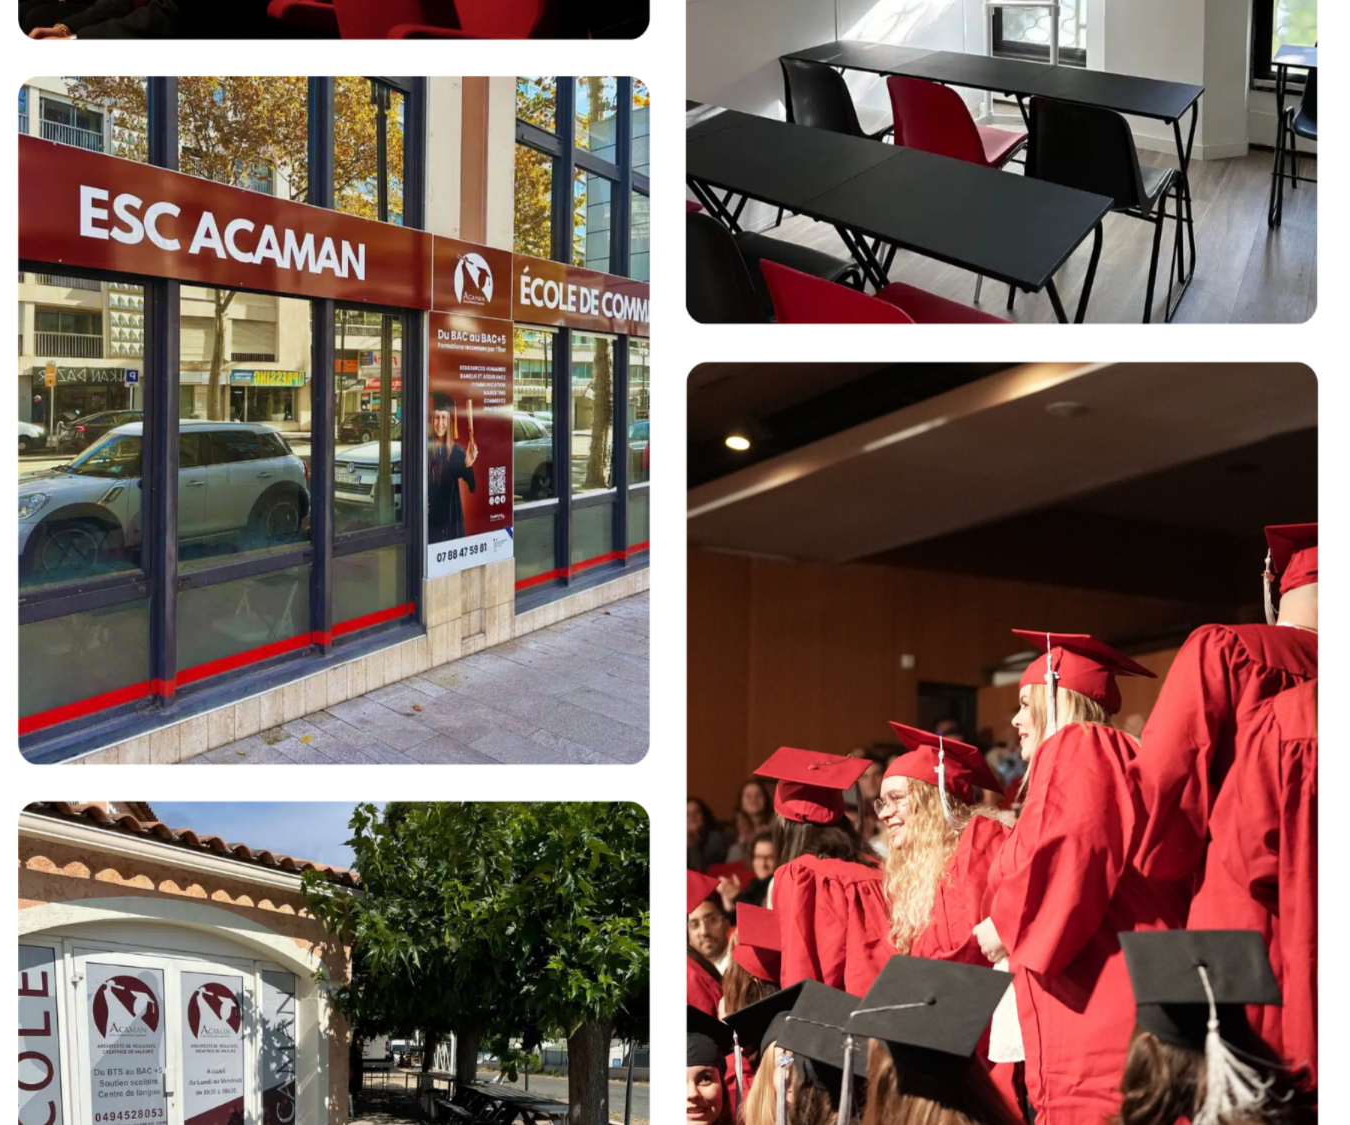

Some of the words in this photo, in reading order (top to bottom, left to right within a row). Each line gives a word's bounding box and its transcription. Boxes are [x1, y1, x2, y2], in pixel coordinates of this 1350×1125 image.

[80, 184, 181, 251] ESC
[188, 210, 366, 281] ACAMAN
[463, 291, 485, 302] ACAMAN
[520, 265, 577, 312] ÉCOLE
[580, 286, 599, 316] DE
[601, 291, 650, 323] COMM
[438, 329, 449, 339] Du
[451, 330, 468, 341] BAC
[469, 333, 480, 342] au
[481, 333, 506, 345] BAC+5
[437, 342, 464, 350] Formations
[436, 552, 446, 563] 07
[447, 549, 458, 560] 88
[459, 546, 468, 557] 47
[469, 544, 478, 555] 59
[479, 542, 487, 553] 81
[109, 1022, 146, 1033] ACAMAN
[200, 1024, 231, 1035] ACAMAN
[107, 1068, 123, 1076] BTS
[136, 1067, 152, 1075] BAC
[99, 1079, 128, 1087] Soutien
[130, 1078, 159, 1086] scolaire
[98, 1090, 124, 1099] Centre
[125, 1089, 135, 1097] de
[136, 1089, 161, 1098] langue
[95, 1108, 163, 1122] 0494528053
